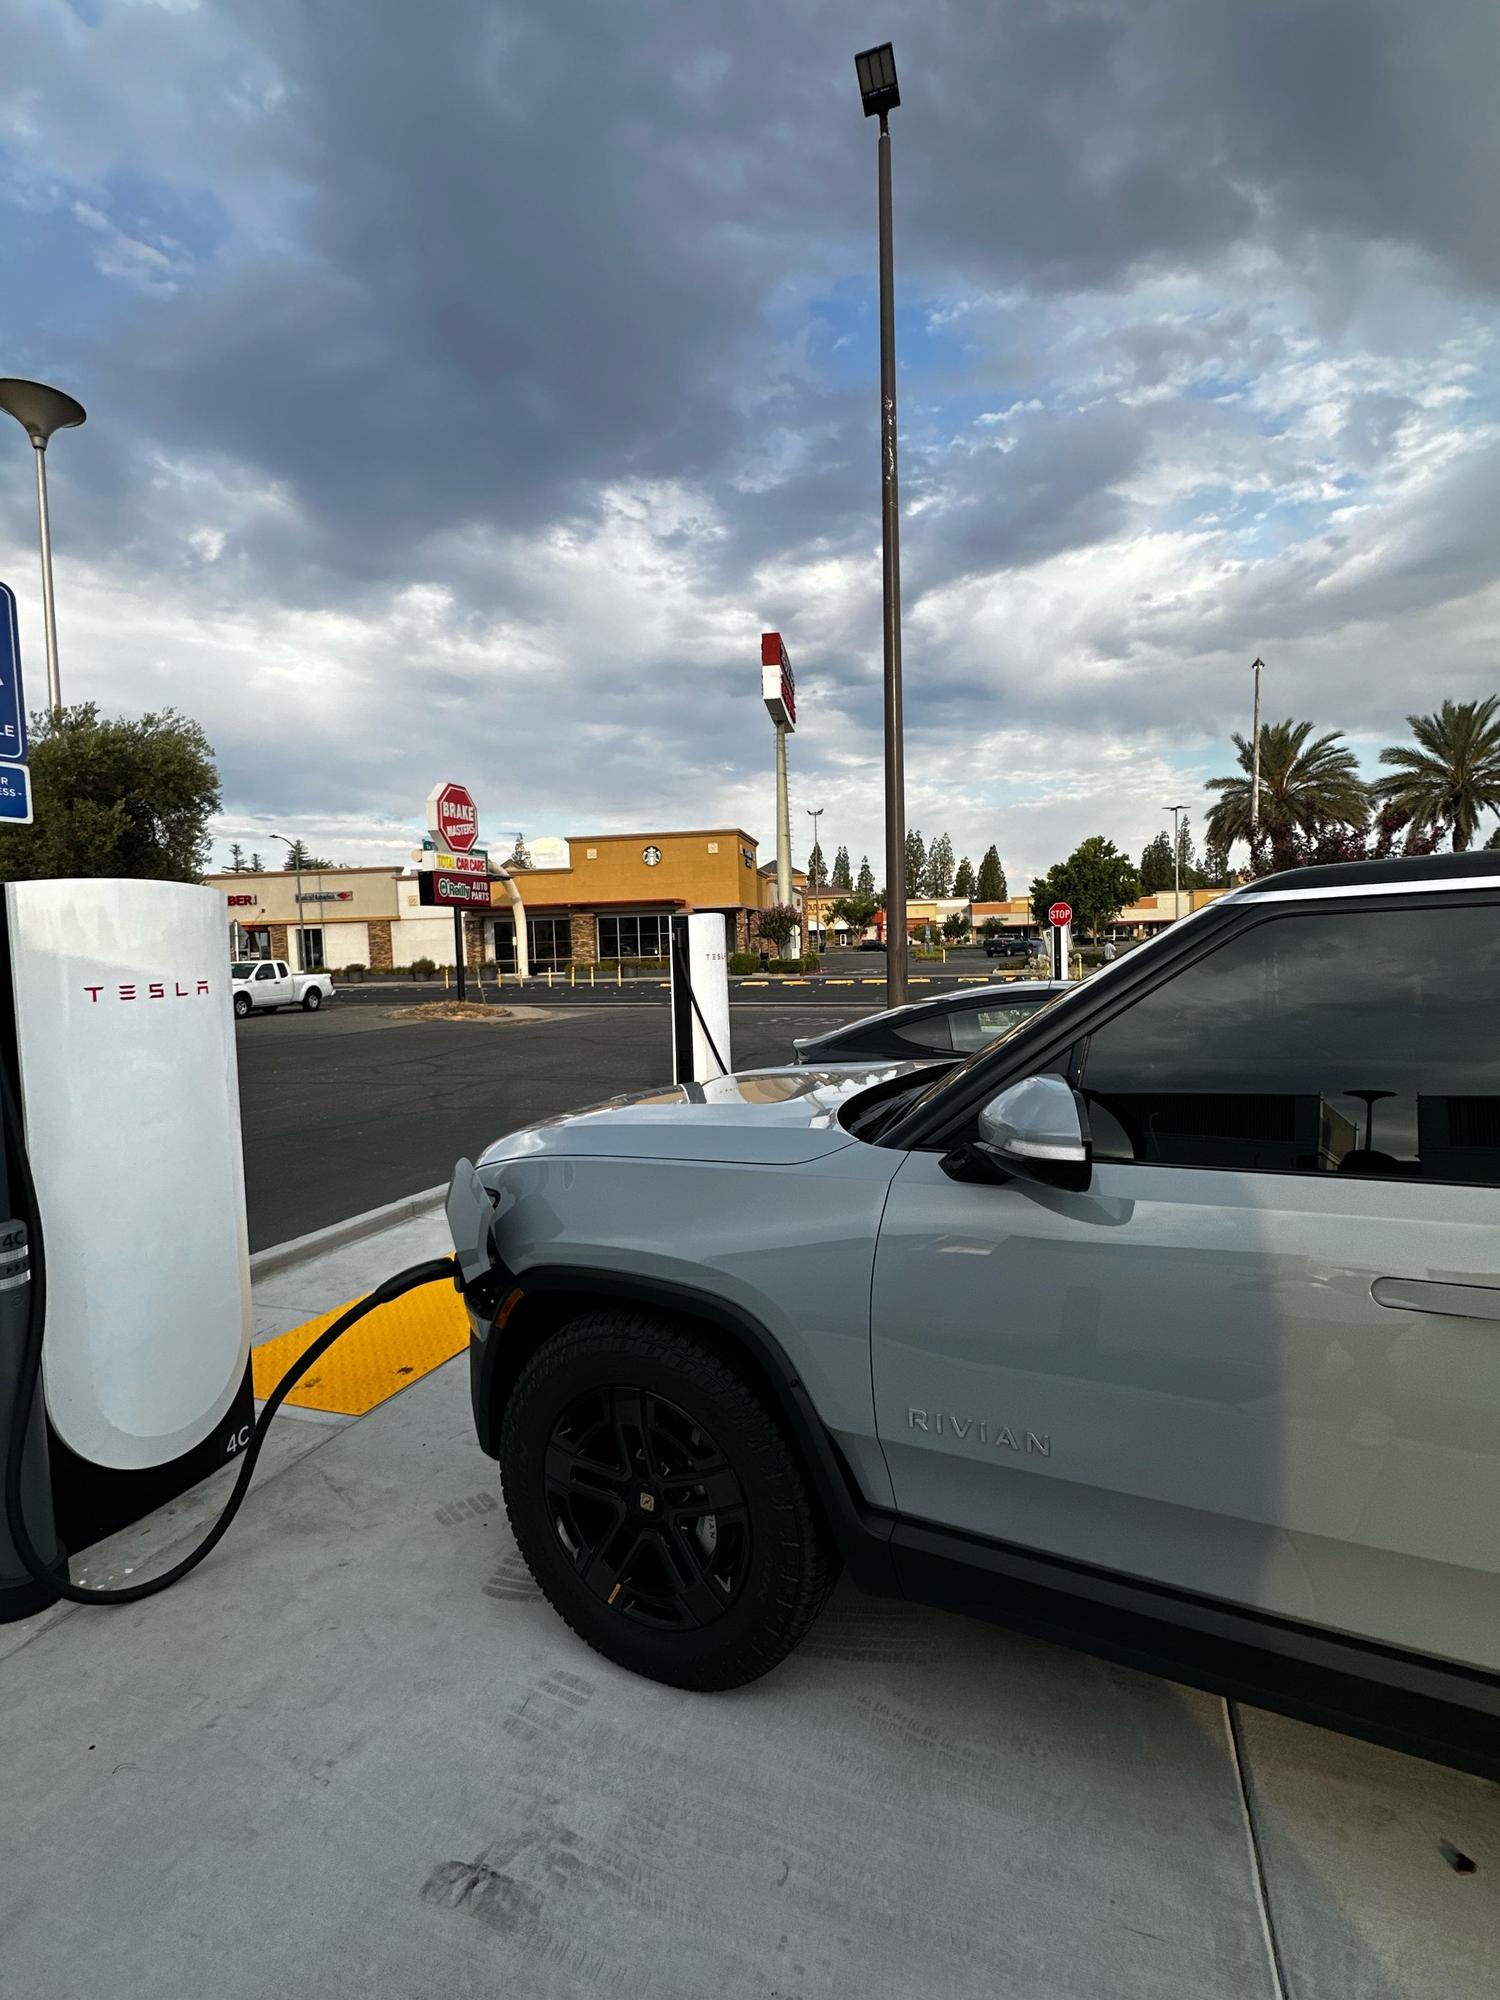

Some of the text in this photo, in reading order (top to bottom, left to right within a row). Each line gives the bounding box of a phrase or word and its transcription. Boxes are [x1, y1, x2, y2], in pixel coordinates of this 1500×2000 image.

[443, 801, 474, 821] BRAKE
[446, 823, 475, 837] MASTERS
[456, 857, 469, 870] CAR
[470, 858, 485, 872] CARE
[438, 878, 471, 900] O'Reilly
[473, 881, 488, 891] AUTO
[471, 891, 489, 901] PARTS
[1050, 909, 1070, 919] STOP
[83, 980, 208, 1002] TESLA
[3, 1230, 24, 1247] 4C
[226, 1425, 249, 1452] 4C
[909, 1407, 1050, 1457] RIVIAN
